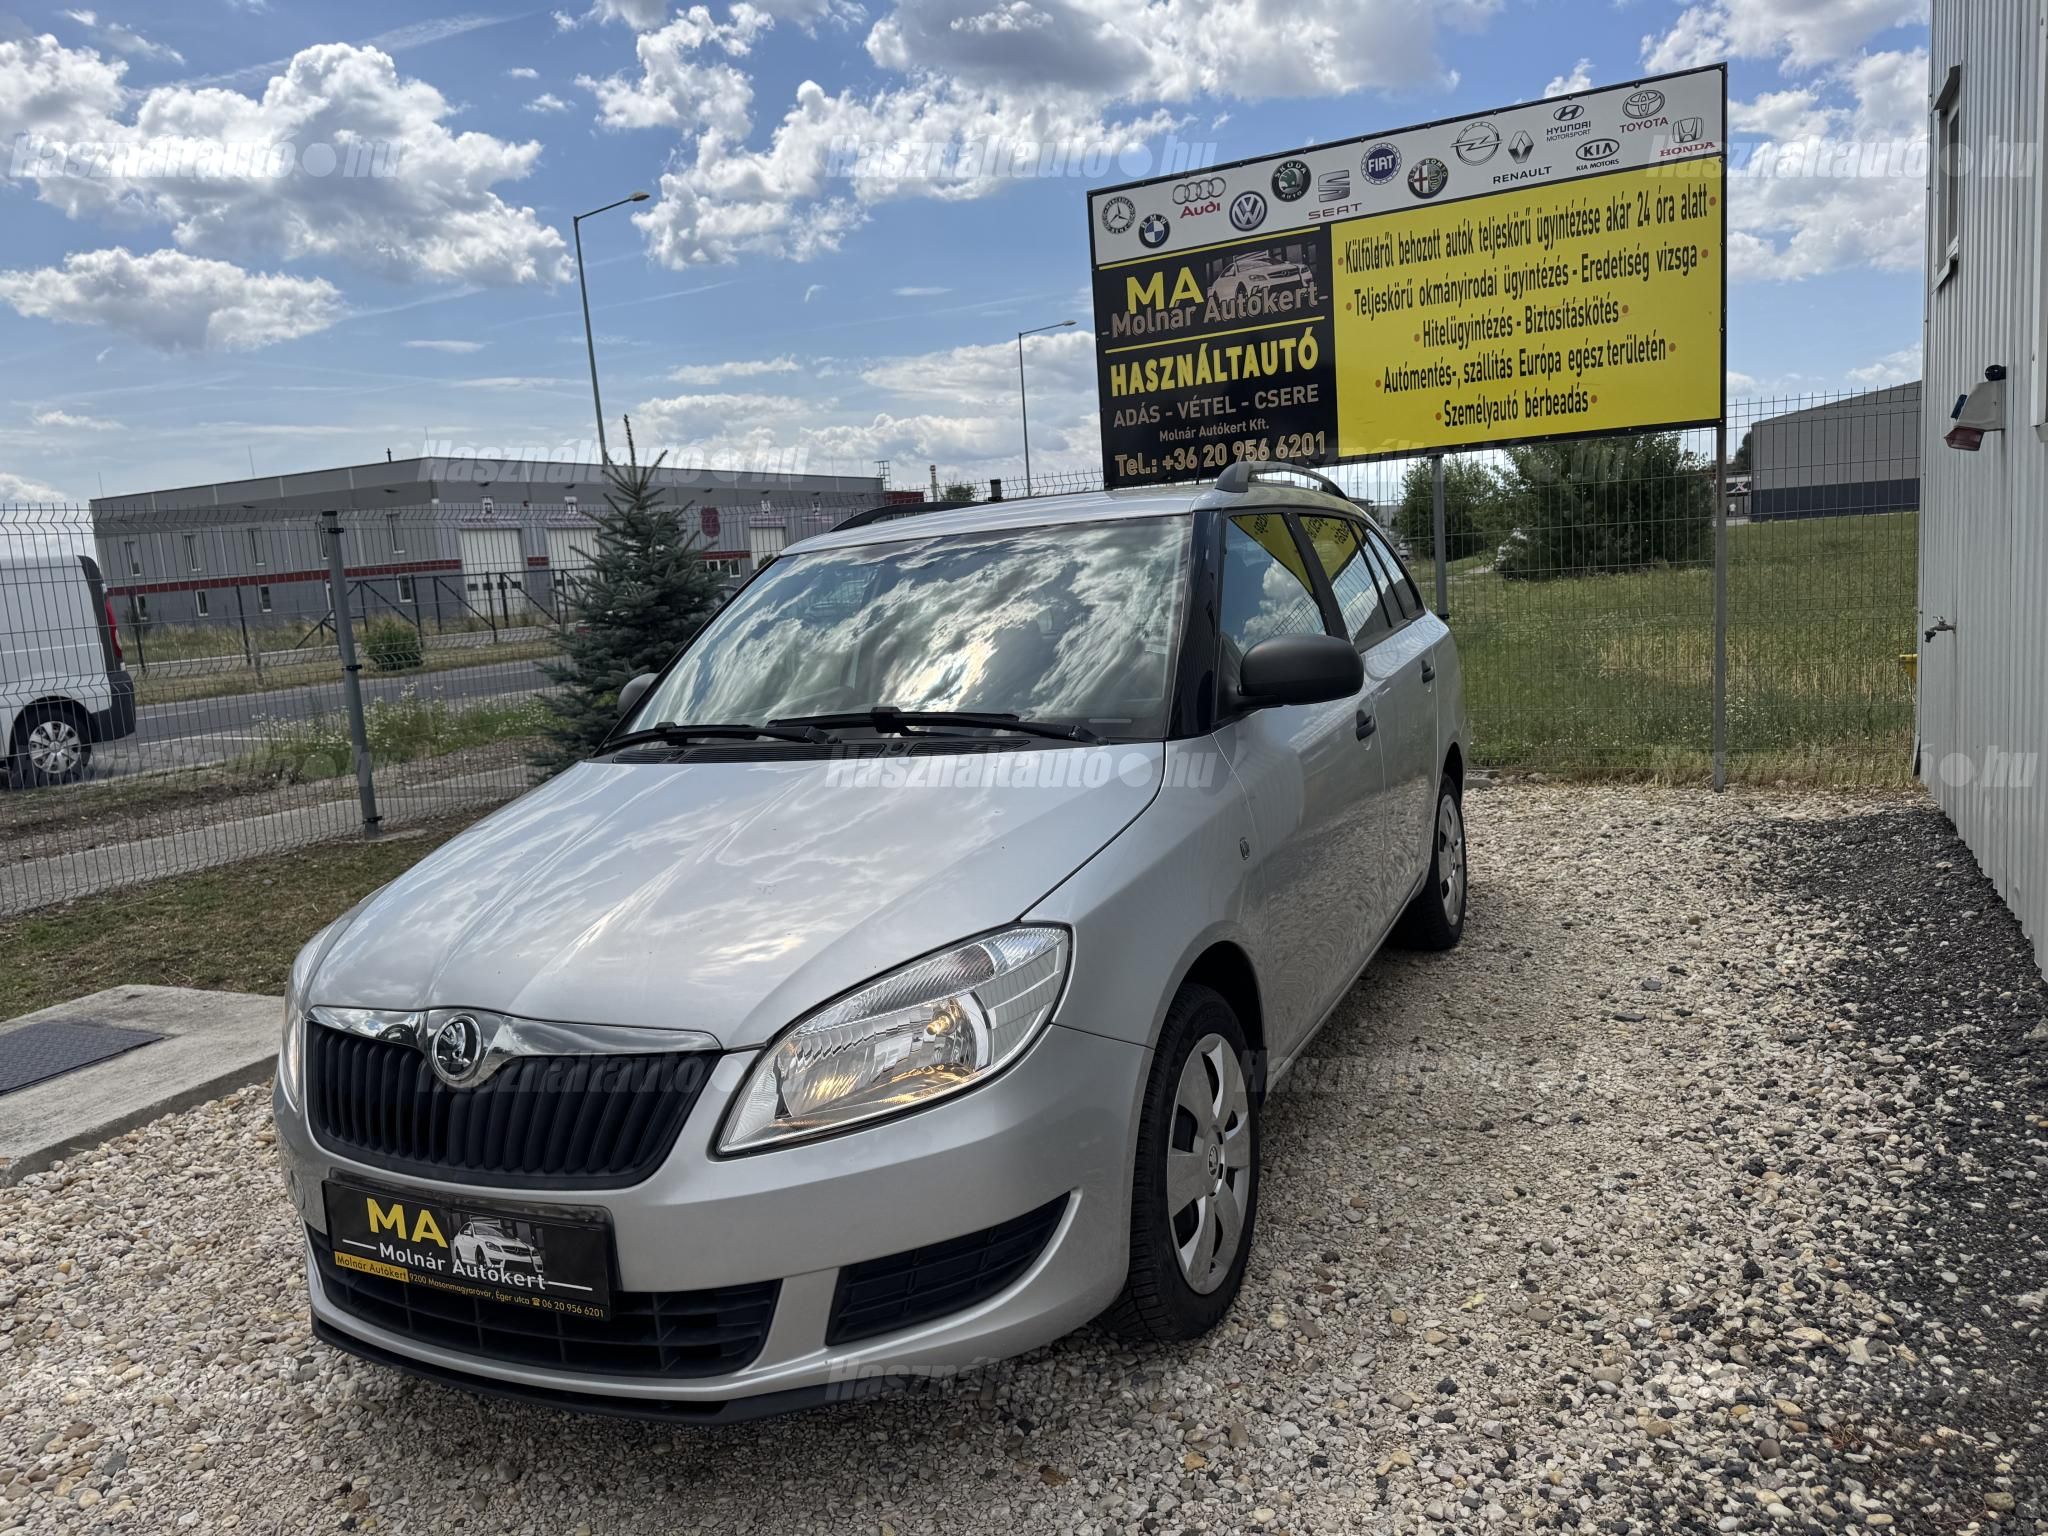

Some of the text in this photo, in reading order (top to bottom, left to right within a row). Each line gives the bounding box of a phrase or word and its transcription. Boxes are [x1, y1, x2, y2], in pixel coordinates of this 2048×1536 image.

[1546, 120, 1592, 136] HYUNDAI
[1546, 129, 1591, 142] MOTORSPORT
[1619, 116, 1669, 134] TOYOTA
[1368, 155, 1394, 173] FIAT
[1576, 158, 1620, 172] KIA MOTORS
[1583, 142, 1613, 157] KIA
[1659, 141, 1716, 157] HONDA
[1492, 165, 1553, 185] RENAULT
[1141, 214, 1168, 229] BMW
[1180, 202, 1221, 219] Audi
[1308, 202, 1362, 220] SEAT
[1345, 183, 1708, 274] Külföldről behozott autók teljeskörű ügyintézése akár 24 óra alatt
[1126, 266, 1204, 315] MA
[1354, 278, 1414, 322] Teljeskörű
[1418, 268, 1498, 311] okmányirodai
[1503, 256, 1569, 302] ügyintézés
[1581, 242, 1650, 284] Eredetiség
[1656, 240, 1698, 277] vizsga
[1112, 281, 1319, 338] Molnár Autókert
[1422, 306, 1513, 351] Hitelügyintézés
[1525, 292, 1619, 335] Biztosításkötés
[1110, 327, 1319, 398] HASZNÁLTAUTÓ
[1463, 347, 1513, 384] szállítás
[1518, 334, 1562, 380] Európa
[1567, 335, 1604, 377] egész
[1607, 329, 1667, 366] területén
[1113, 402, 1161, 428] ADÁS
[1176, 394, 1237, 420] VÉTEL
[1254, 383, 1320, 410] CSERE
[1443, 382, 1589, 429] Személyautó bérbeadás
[1159, 418, 1270, 442] Molnár Autókert Kft.
[1114, 453, 1158, 477] Tel.:
[1162, 446, 1198, 471] +36
[1202, 443, 1228, 468] 20
[1232, 437, 1270, 463] 956
[1275, 430, 1326, 459] 6201
[366, 1197, 448, 1249] MA
[337, 1255, 367, 1271] Molnár
[369, 1263, 407, 1280] Autókert
[409, 1273, 427, 1285] 9200
[542, 1299, 553, 1309] 06
[554, 1301, 565, 1311] 20
[566, 1303, 582, 1314] 956
[584, 1307, 604, 1318] 6201
[379, 1241, 546, 1291] Molnár Autókert
